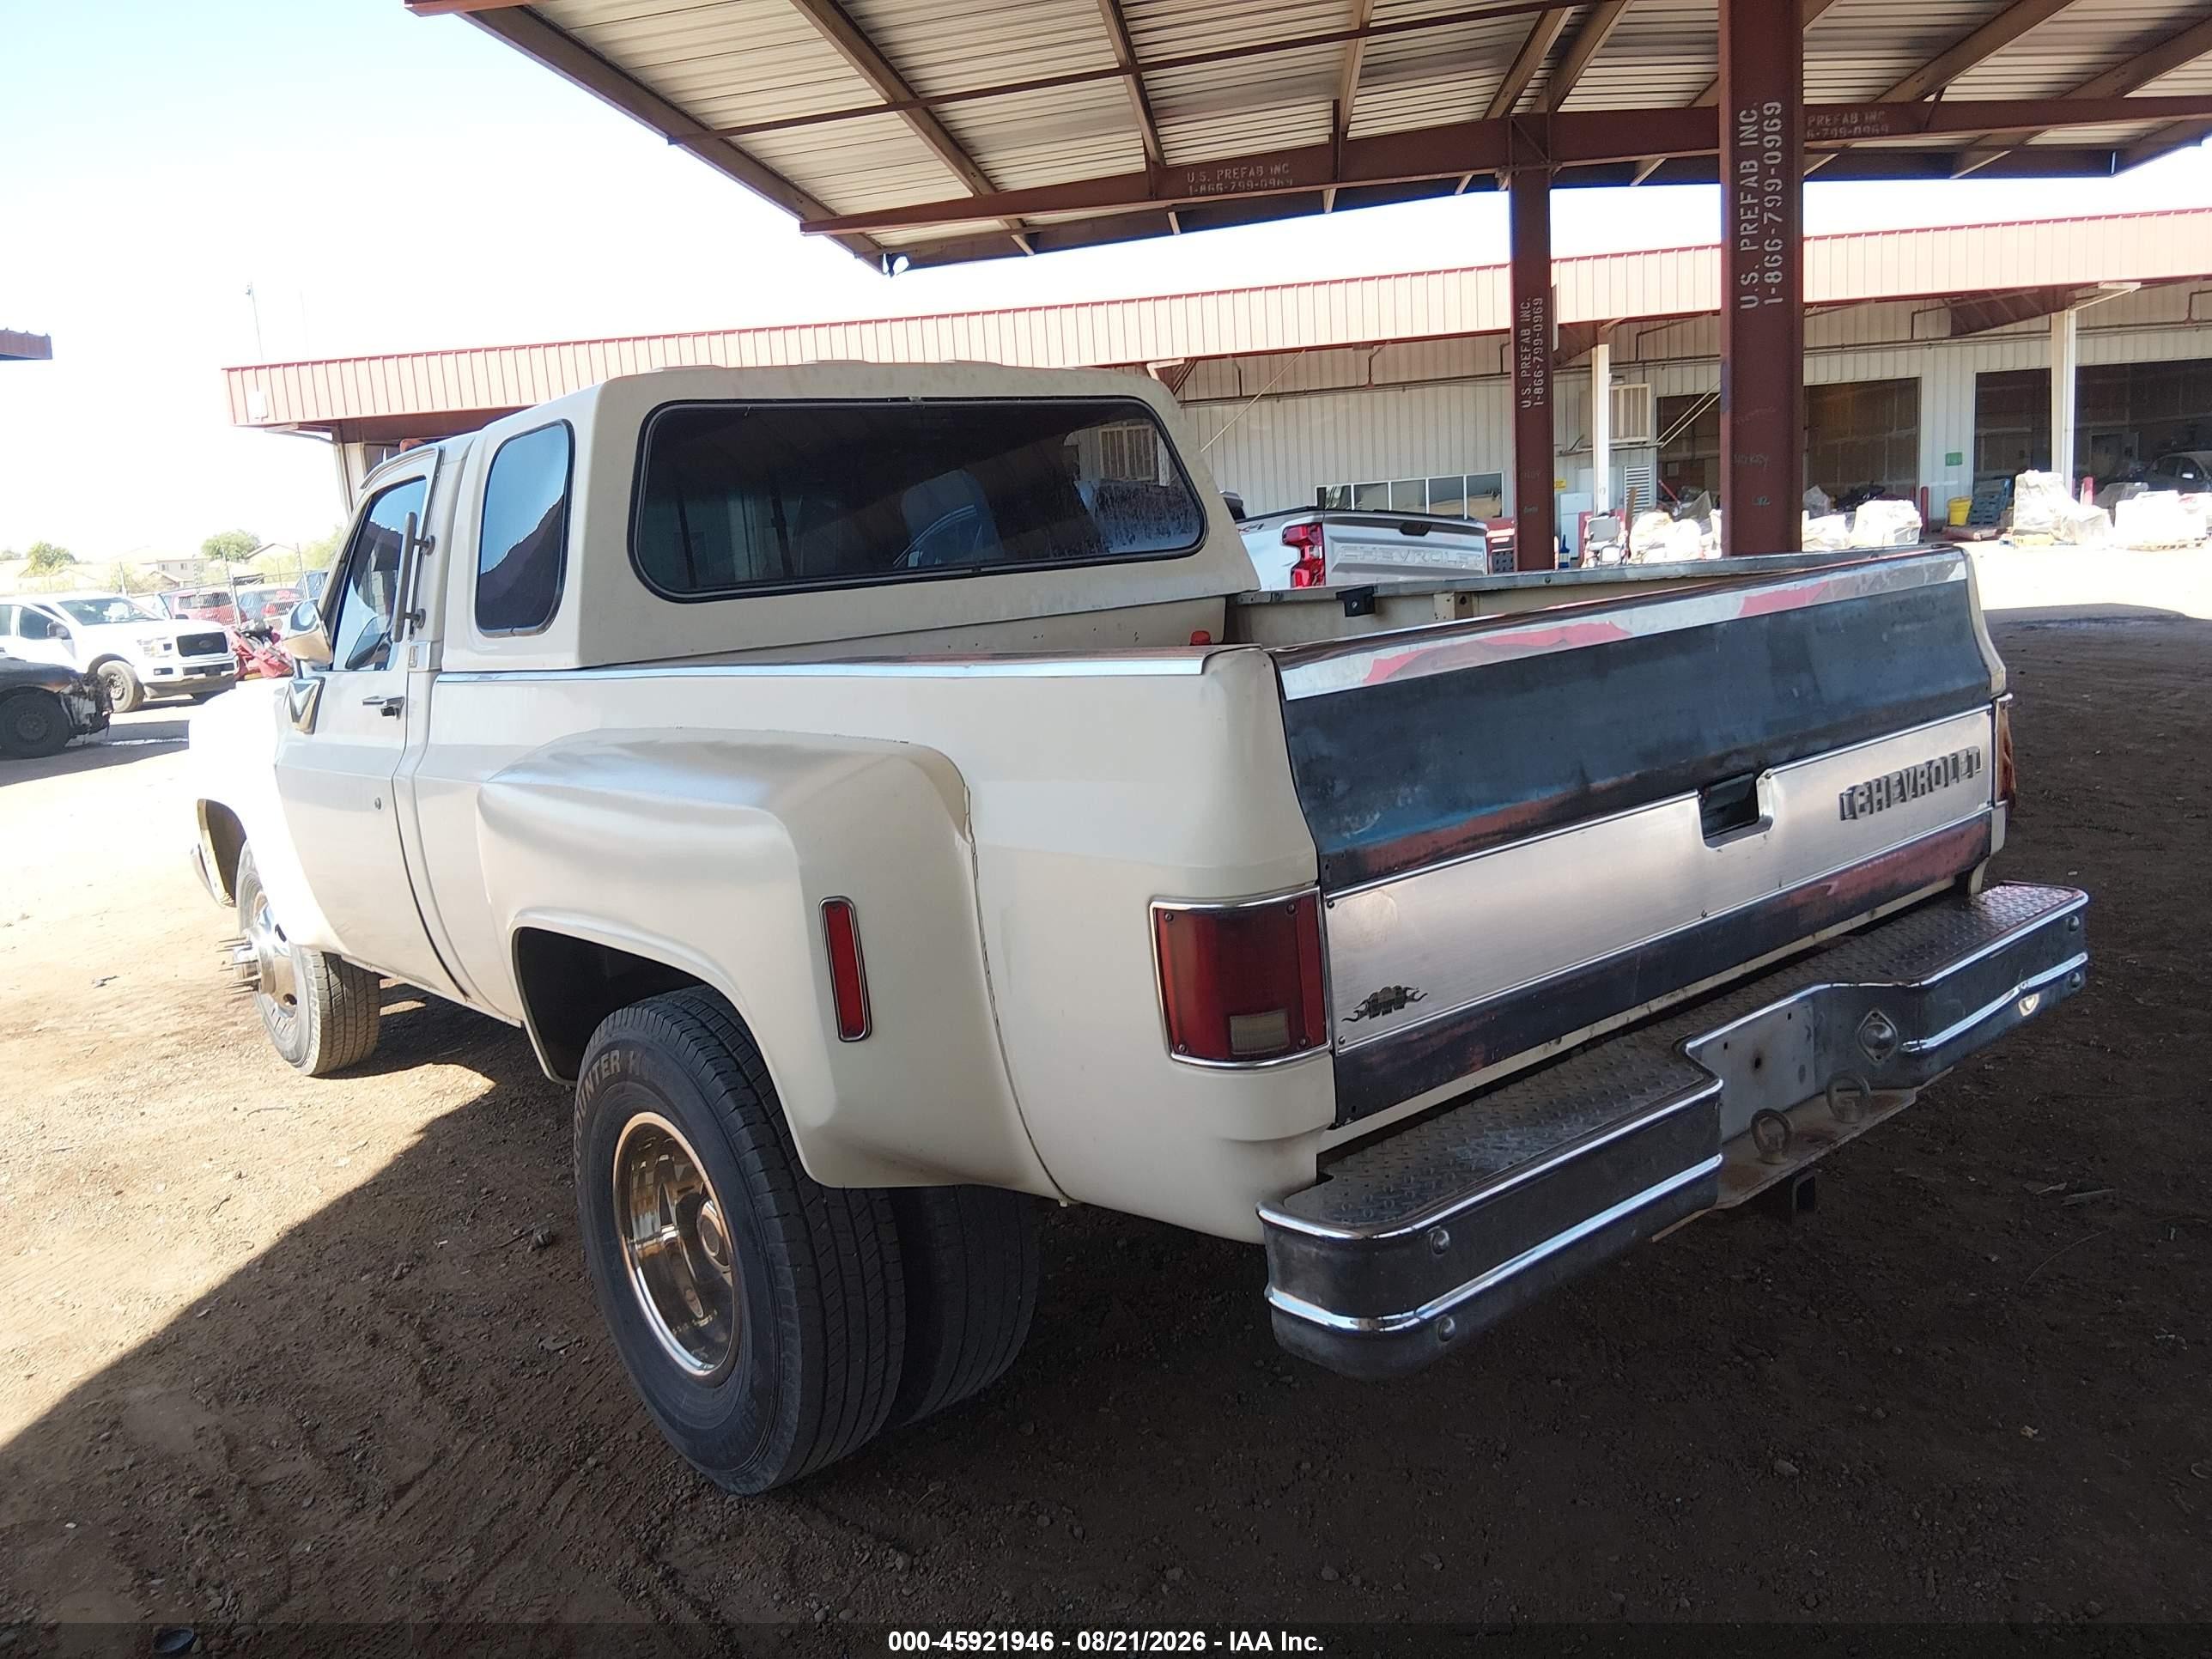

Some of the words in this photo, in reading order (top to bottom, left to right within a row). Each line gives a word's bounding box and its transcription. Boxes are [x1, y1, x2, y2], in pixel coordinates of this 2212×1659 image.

[1187, 172, 1211, 184] US.
[1217, 165, 1264, 181] PREFAB
[1740, 160, 1759, 251] PREFAB
[1763, 101, 1784, 305] 1-866-799-0969
[1520, 298, 1531, 322] INC.
[1740, 264, 1759, 309] U.S.
[1520, 329, 1531, 377] PREFAB
[1533, 297, 1544, 406] 1-866-799-0969
[1521, 384, 1532, 409] U.S.
[1839, 745, 1982, 821] CHEVROLET
